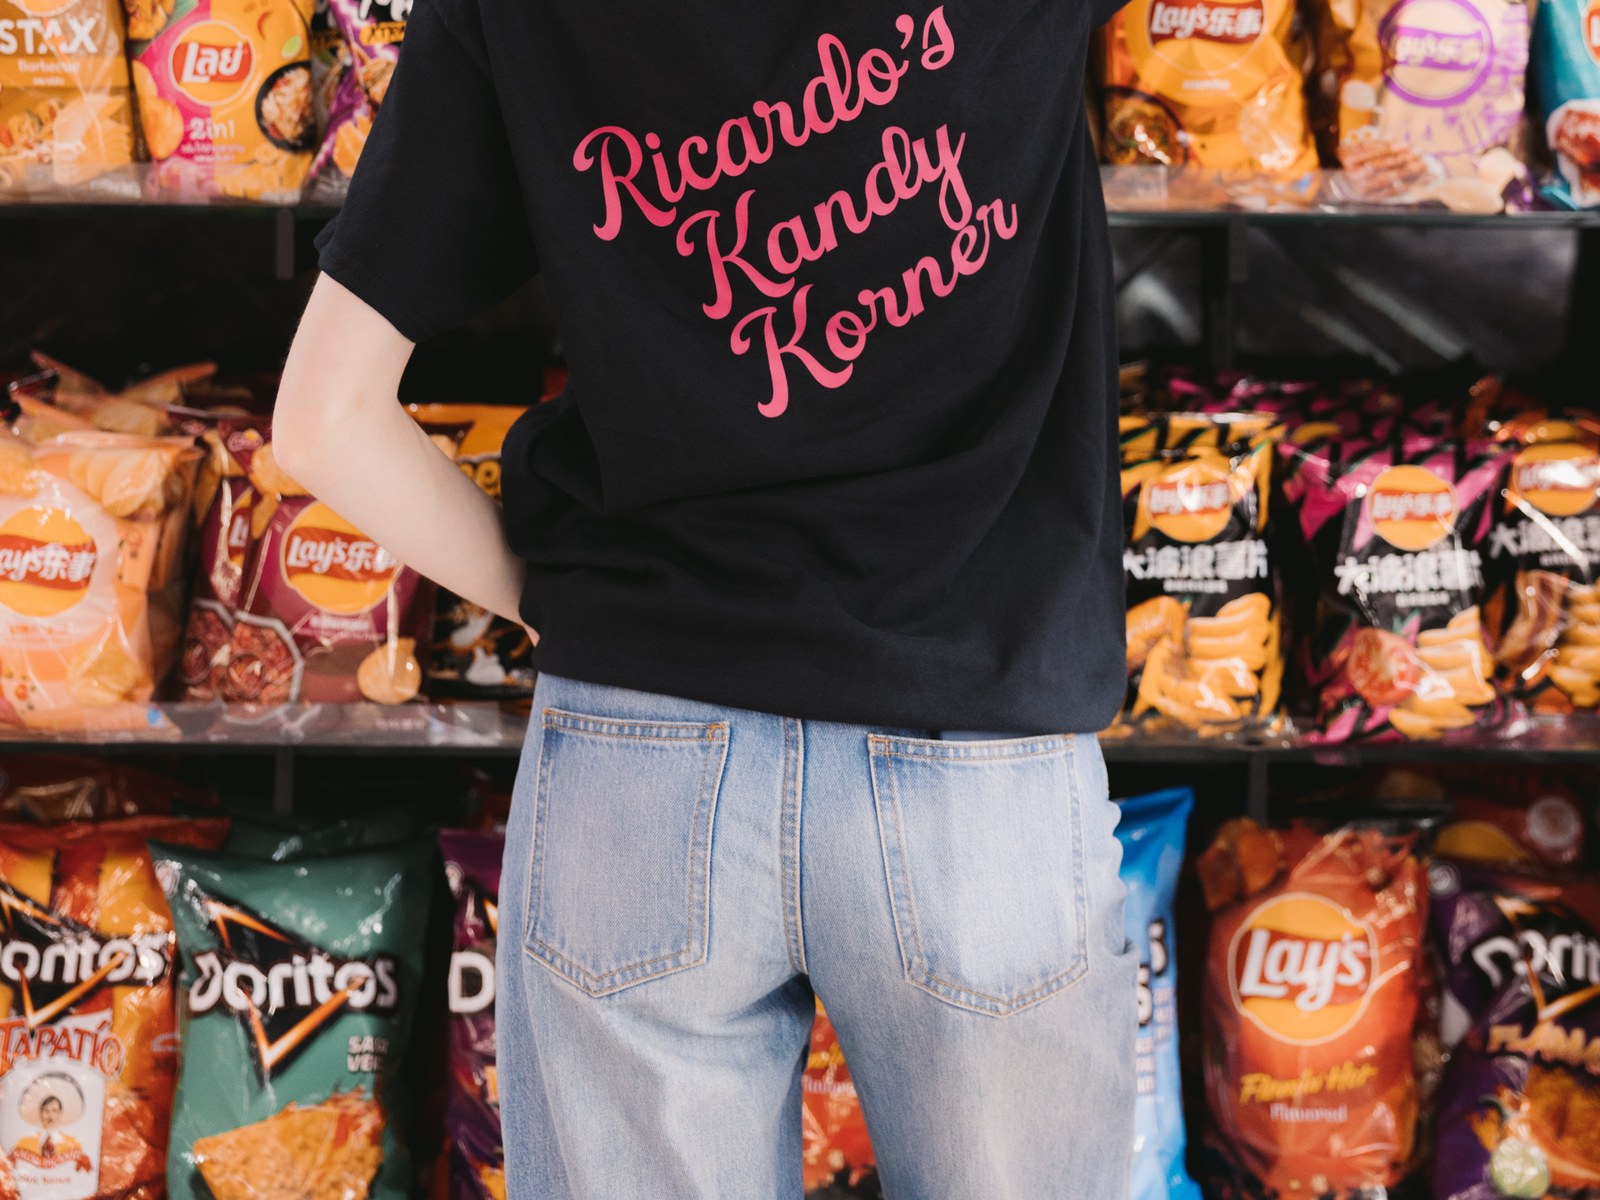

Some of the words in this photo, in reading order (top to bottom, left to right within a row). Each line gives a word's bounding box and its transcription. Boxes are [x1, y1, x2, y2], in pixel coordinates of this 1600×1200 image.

[0, 17, 97, 54] STAX
[1151, 2, 1209, 40] Lay's
[573, 5, 955, 241] Ricardo's
[676, 124, 966, 319] Kandy
[730, 198, 1018, 418] Korner
[286, 535, 348, 574] Lay's
[189, 950, 398, 1012] Doritos
[1240, 928, 1368, 1012] Lay's
[1270, 1103, 1348, 1122] Flavored
